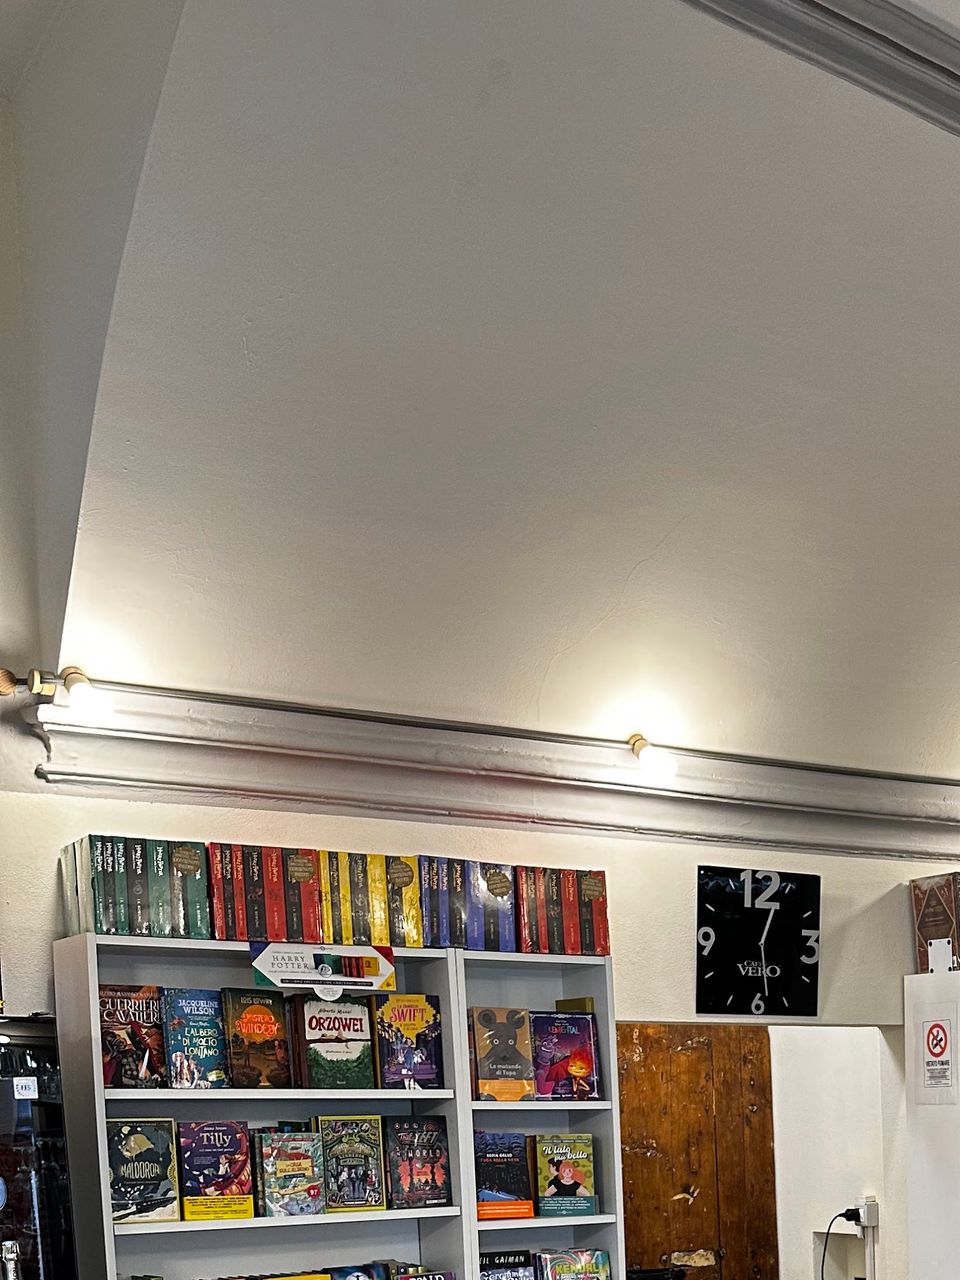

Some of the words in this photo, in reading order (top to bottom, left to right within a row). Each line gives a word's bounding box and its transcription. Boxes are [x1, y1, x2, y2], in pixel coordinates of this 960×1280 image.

[740, 869, 780, 909] 12
[698, 926, 715, 955] 9
[800, 929, 820, 964] 3
[271, 962, 309, 970] POTTER
[737, 964, 781, 978] VERO
[178, 999, 218, 1008] JACQUELINE
[751, 992, 765, 1015] 6
[183, 1006, 215, 1015] WILSON
[390, 1008, 427, 1023] SWIFT
[308, 1015, 364, 1032] ORZOWEI
[185, 1028, 218, 1037] L'ALBERO
[182, 1038, 191, 1047] DI
[192, 1037, 218, 1047] MOLTO
[185, 1046, 219, 1058] LONTANO
[200, 1132, 232, 1148] Tilly
[553, 1145, 571, 1154] lato
[567, 1151, 588, 1160] bello
[121, 1161, 160, 1179] MALDOROR
[495, 1256, 525, 1264] GAIMAN
